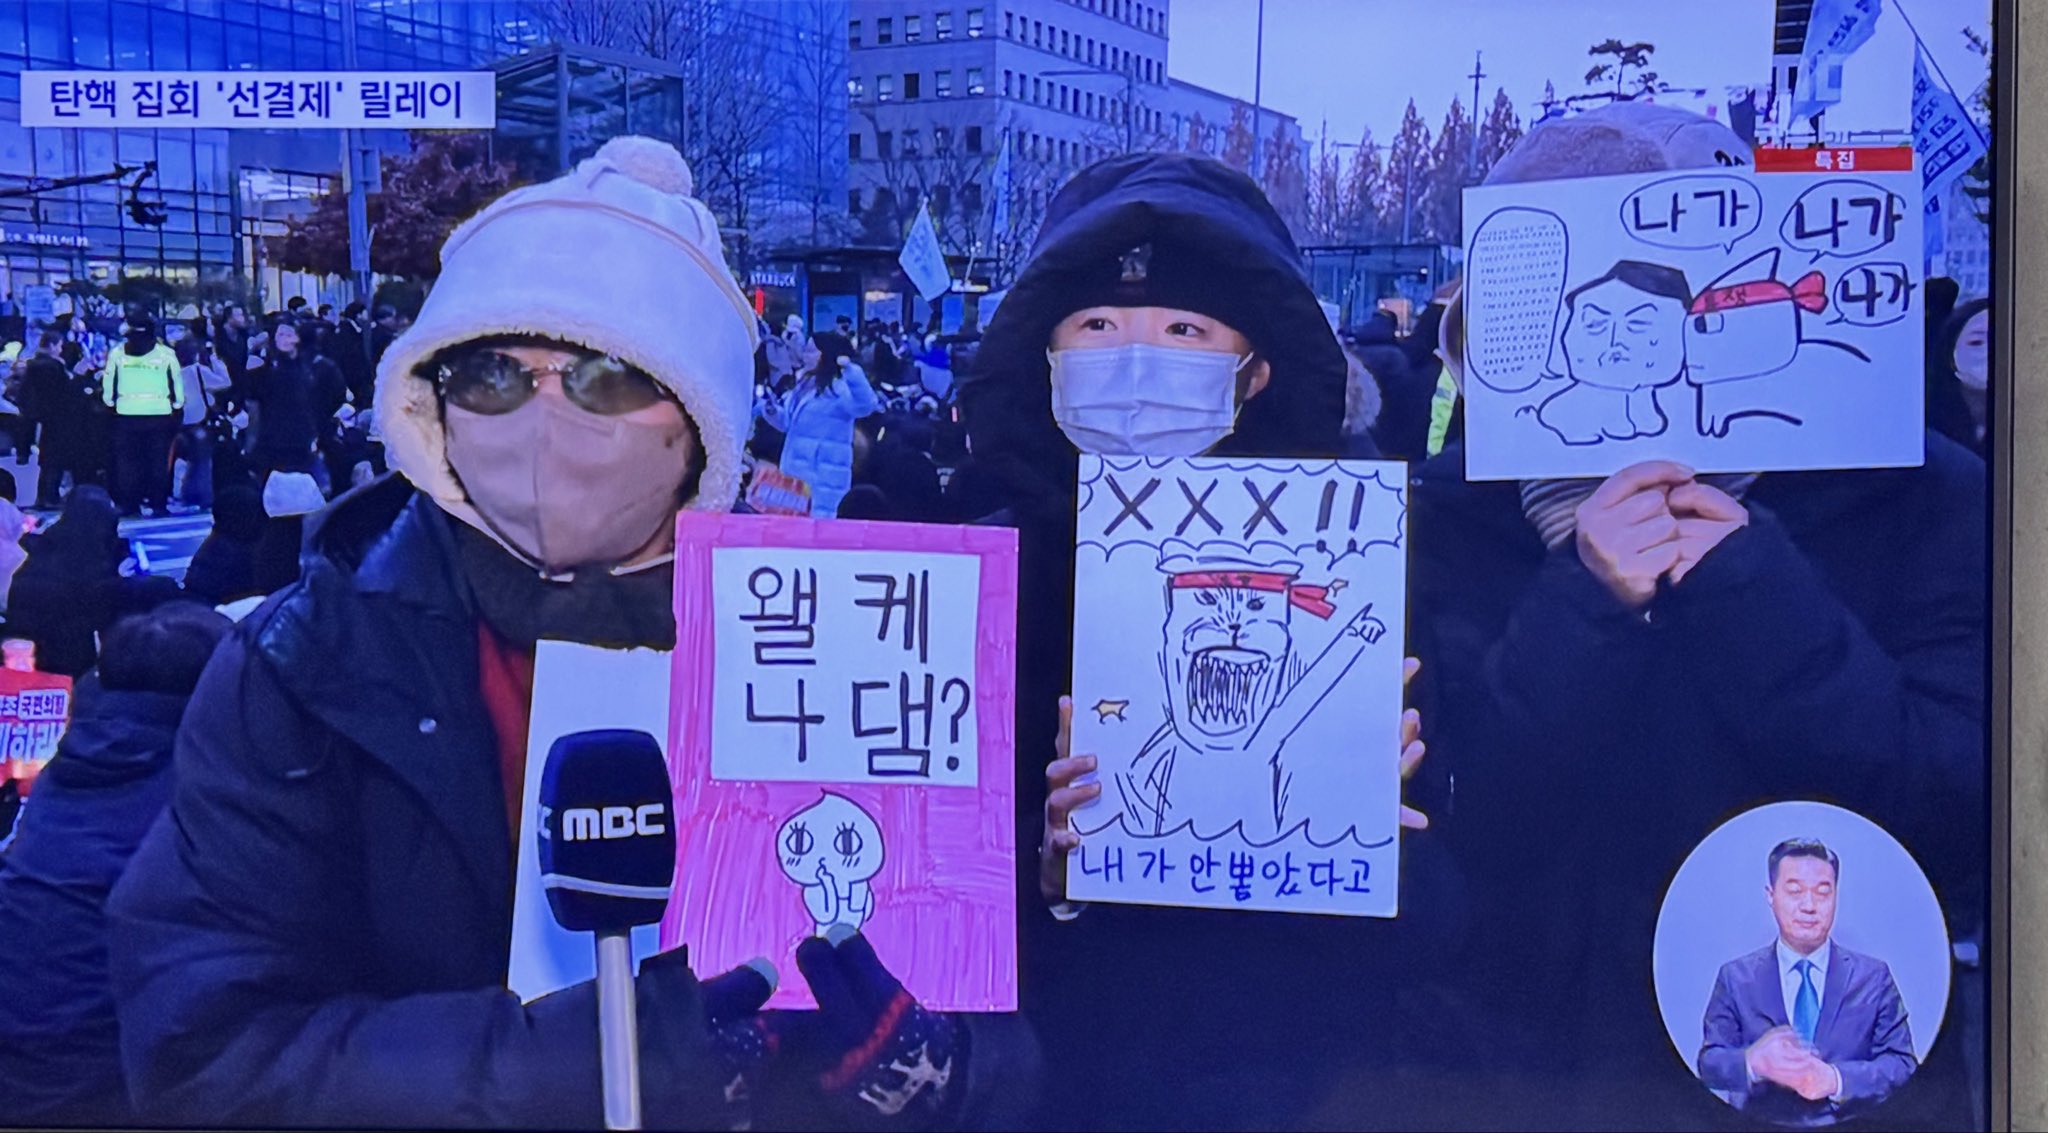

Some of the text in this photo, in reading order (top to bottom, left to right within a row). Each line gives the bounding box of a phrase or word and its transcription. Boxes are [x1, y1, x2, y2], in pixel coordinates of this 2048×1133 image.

[49, 79, 462, 119] 탄핵 집회 '선결제' 릴레이
[1815, 151, 1855, 170] 특집
[1633, 188, 1750, 233] 나가
[1794, 192, 1903, 248] 나가
[1841, 267, 1918, 318] 나가
[562, 802, 666, 841] MBC
